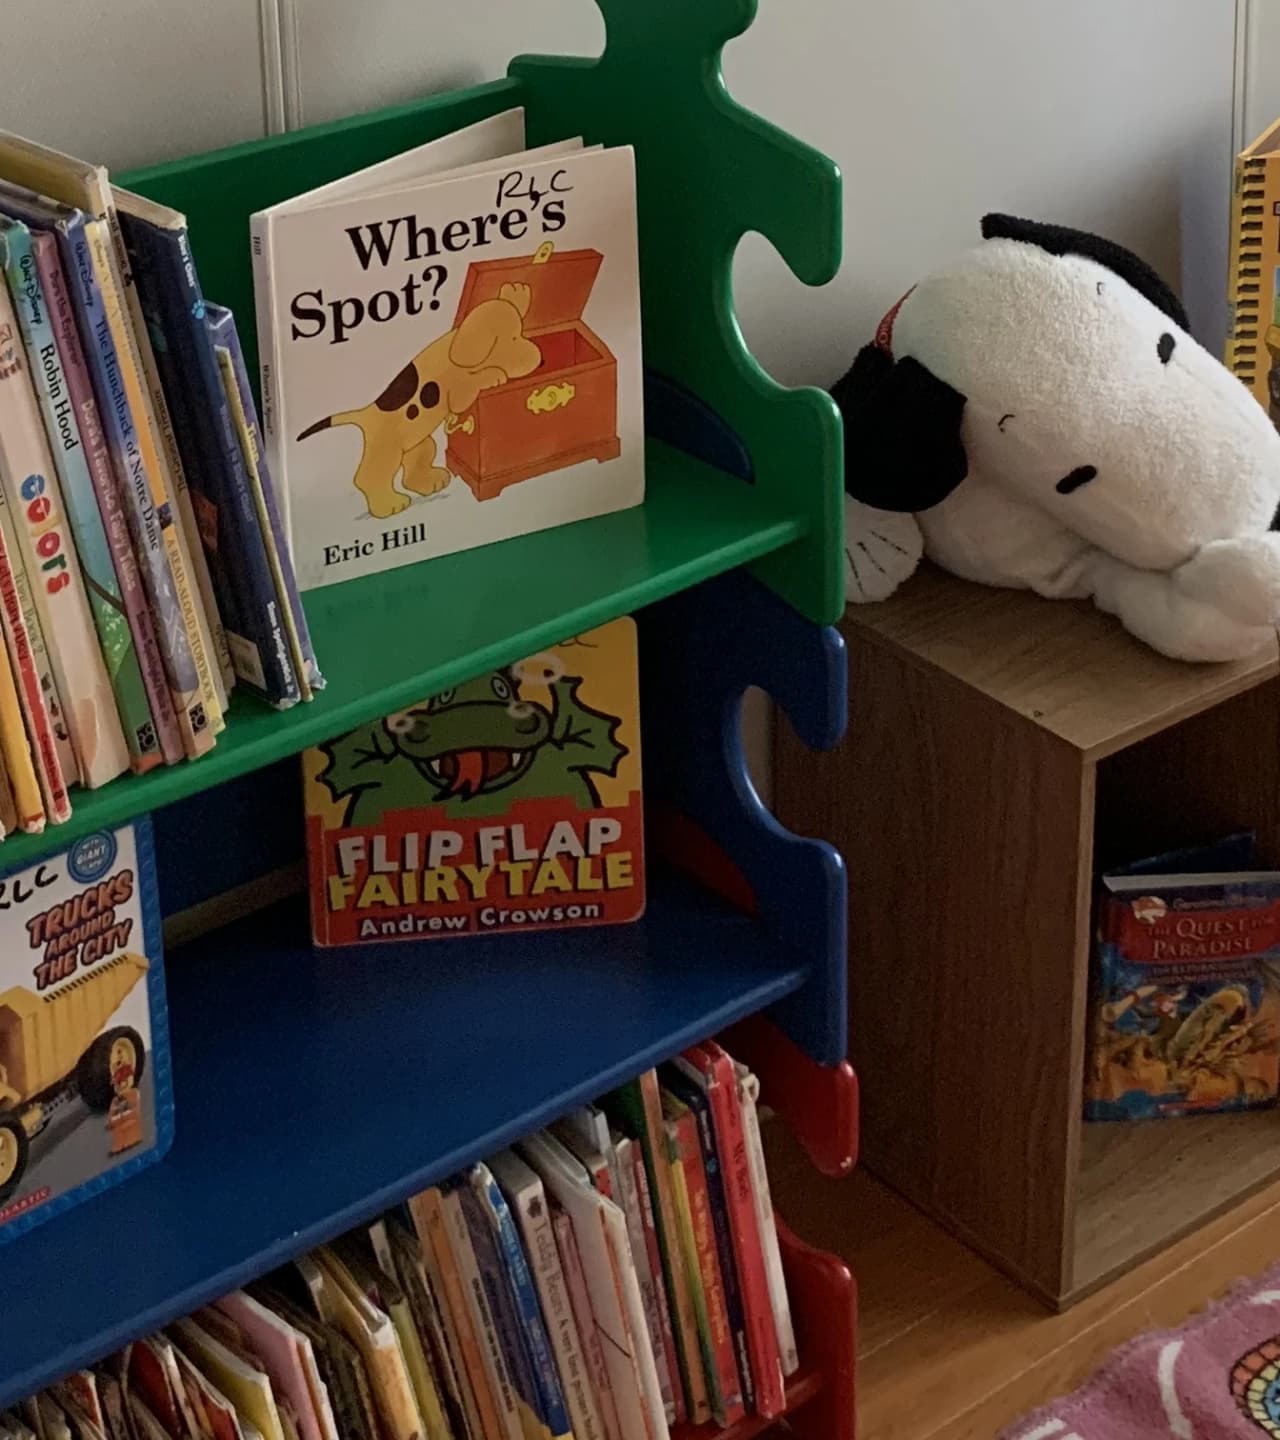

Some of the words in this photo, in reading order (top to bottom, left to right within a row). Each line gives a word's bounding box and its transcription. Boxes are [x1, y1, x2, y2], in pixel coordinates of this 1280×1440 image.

[344, 197, 567, 271] Where's
[290, 264, 449, 345] Spot?
[93, 316, 110, 349] The
[38, 342, 65, 399] Robin
[52, 400, 79, 451] Hood
[101, 351, 136, 437] Hunchback
[79, 398, 102, 447] Dora's
[124, 439, 141, 457] of
[93, 447, 119, 510] Favorite
[128, 458, 151, 505] Notre
[17, 471, 74, 595] colors
[109, 511, 129, 550] Fairy
[141, 506, 160, 551] Dame
[165, 537, 176, 547] A
[322, 539, 374, 567] Eric
[381, 523, 428, 552] Hill
[117, 550, 138, 591] Tales
[167, 550, 197, 629] READ-ALOUD
[187, 629, 216, 702] STORYBOOK
[338, 829, 464, 878] FLIP
[478, 817, 623, 865] FLAP
[327, 850, 634, 911] FAIRYTALE
[25, 868, 134, 949] TRUCKS
[361, 914, 468, 938] Andrew
[480, 904, 600, 927] Crowson
[1176, 917, 1247, 942] QUEST
[33, 950, 80, 990] THE
[80, 918, 133, 966] CITY
[45, 910, 116, 959] AROUND
[1153, 938, 1253, 960] PARADISE
